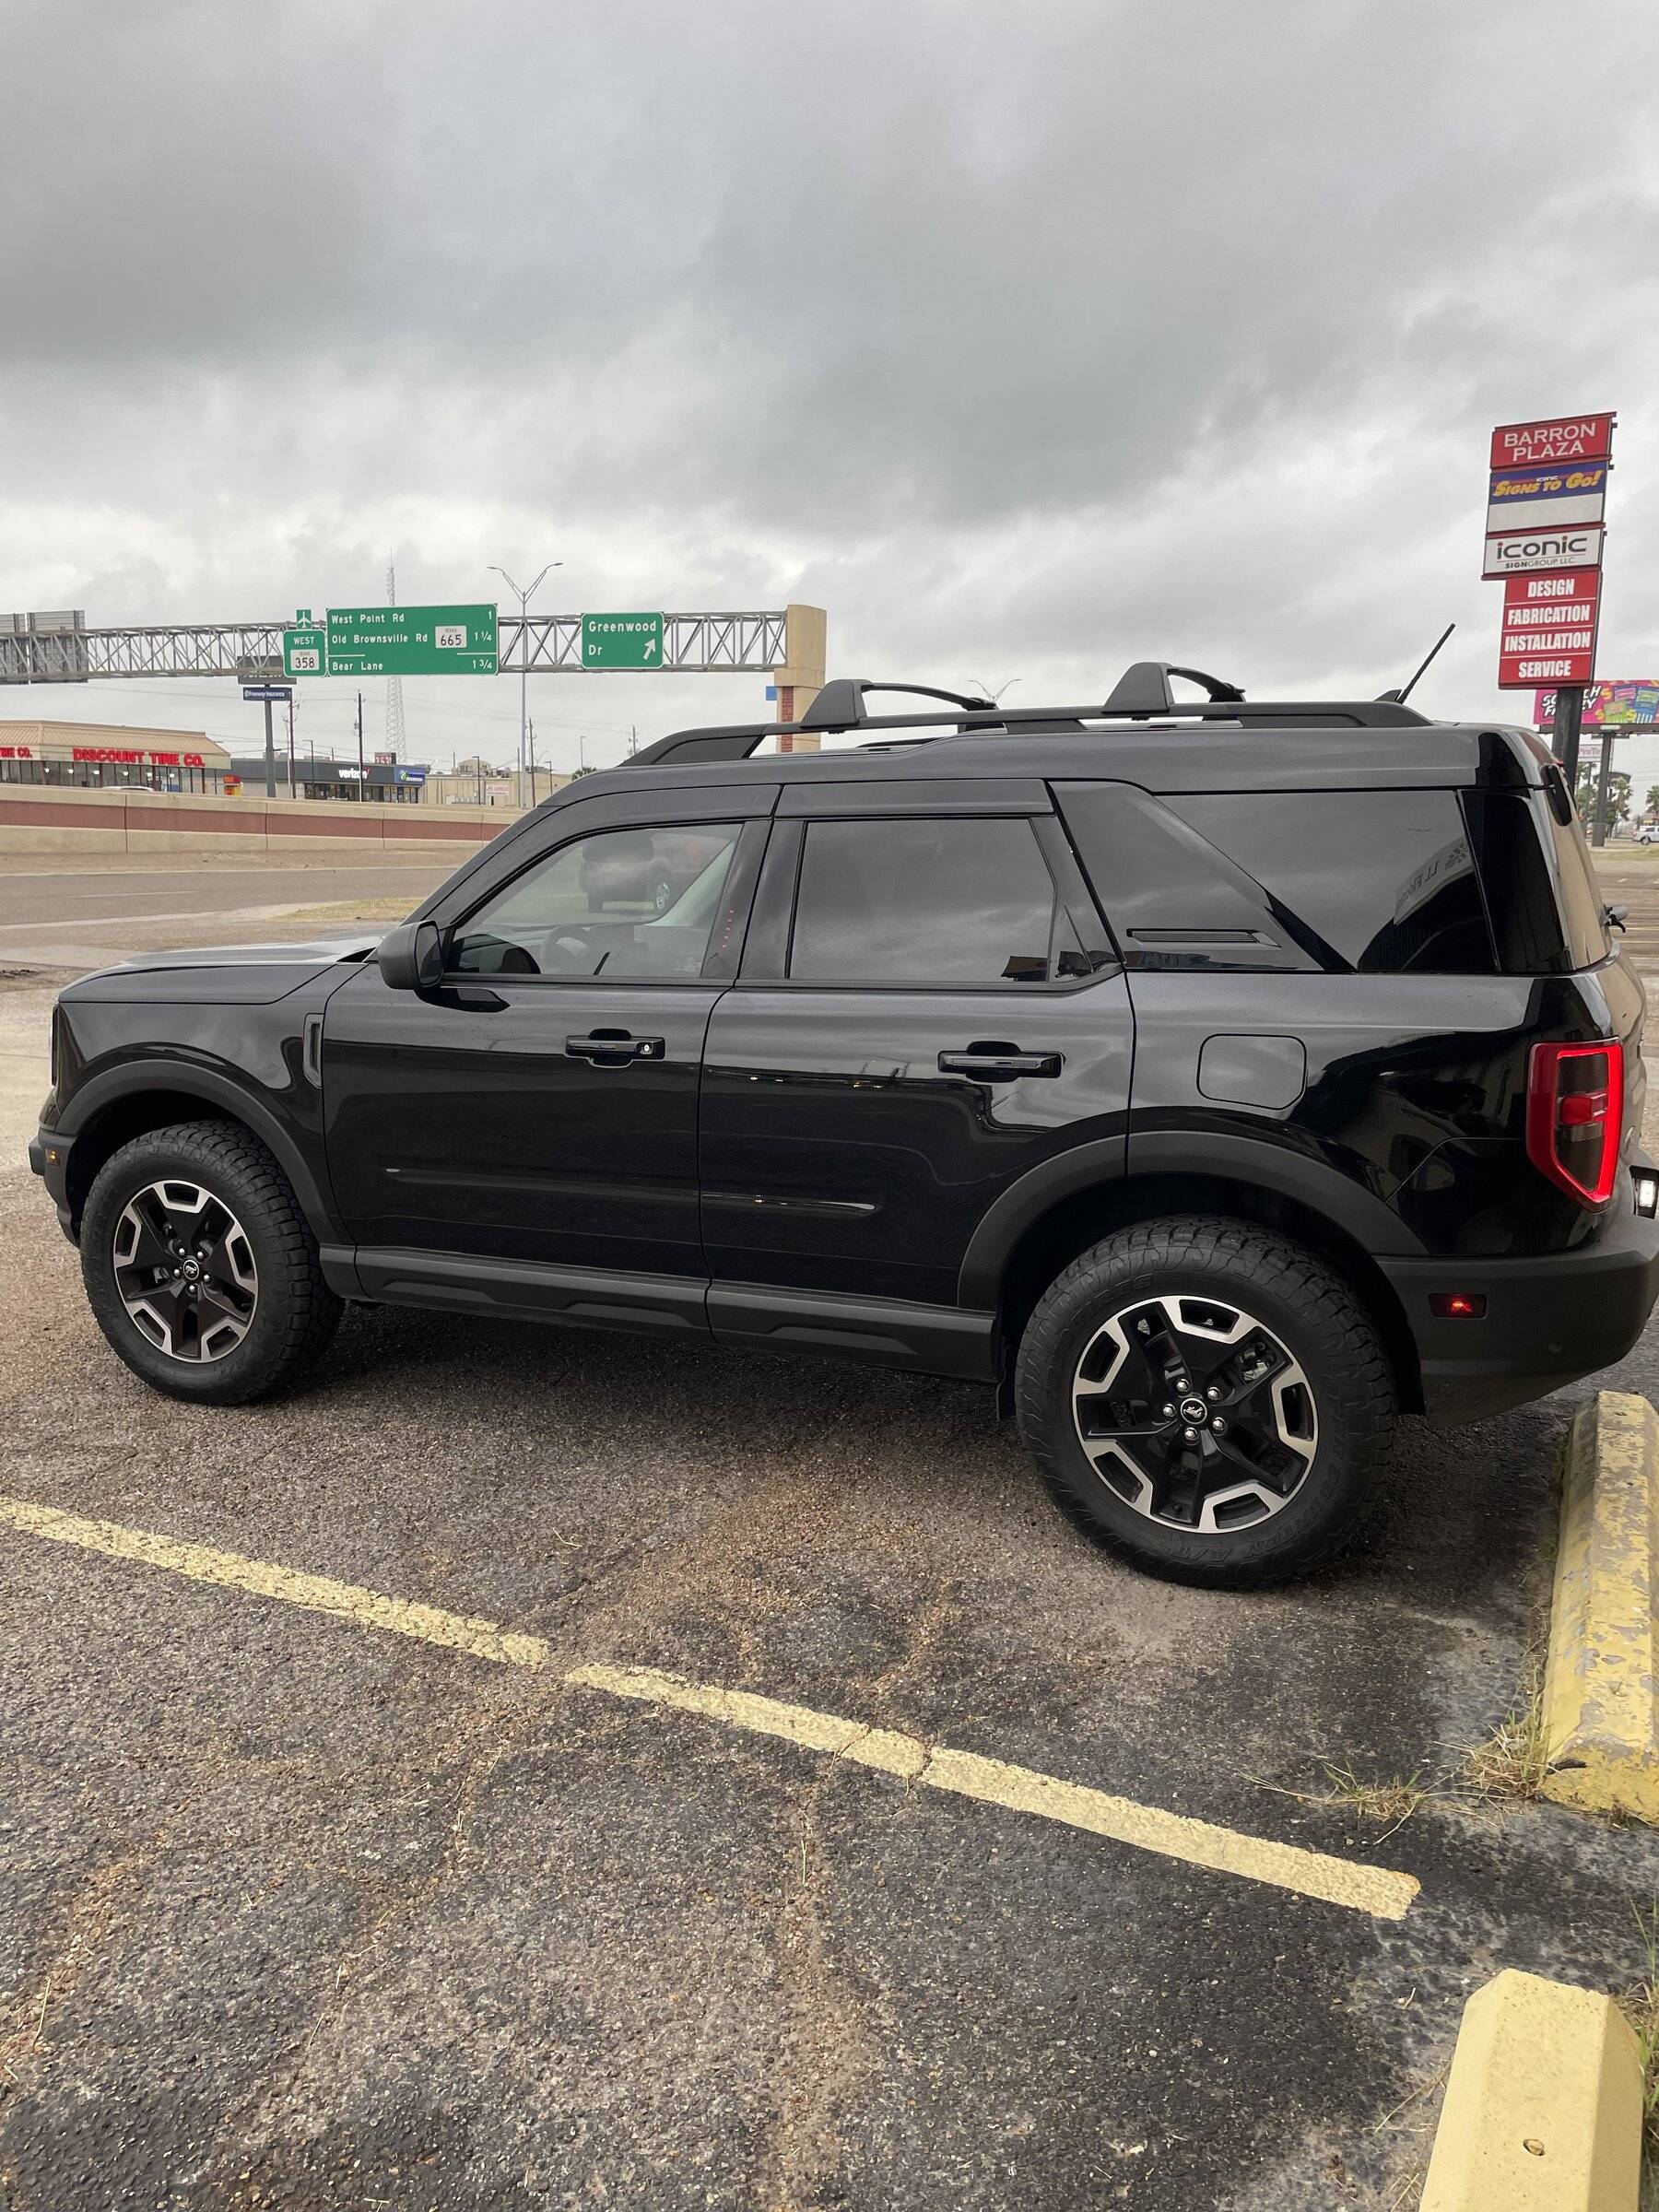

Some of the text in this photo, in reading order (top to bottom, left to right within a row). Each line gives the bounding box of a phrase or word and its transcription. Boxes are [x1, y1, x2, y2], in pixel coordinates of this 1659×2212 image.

[1503, 422, 1596, 448] BARRON
[1512, 440, 1584, 462] PLAZA
[1496, 535, 1587, 559] iconic
[1527, 578, 1575, 598] DESIGN
[331, 611, 492, 624] West Point Rd 1
[1507, 605, 1591, 626] FABRICATION
[588, 620, 657, 632] Greenwood
[293, 637, 315, 645] WEST
[332, 634, 347, 644] Old
[353, 633, 408, 644] Brownsville
[416, 633, 428, 642] Rd
[440, 634, 462, 646] 665
[1504, 631, 1592, 653] INSTALLATION
[588, 645, 603, 655] Dr
[295, 657, 315, 668] 358
[333, 662, 354, 671] Bear
[361, 661, 383, 671] Lane
[472, 659, 477, 669] 1
[1518, 659, 1572, 677] SERVICE
[17, 747, 33, 759] CO.
[73, 747, 206, 767] DISCOUNT TIRE CO.
